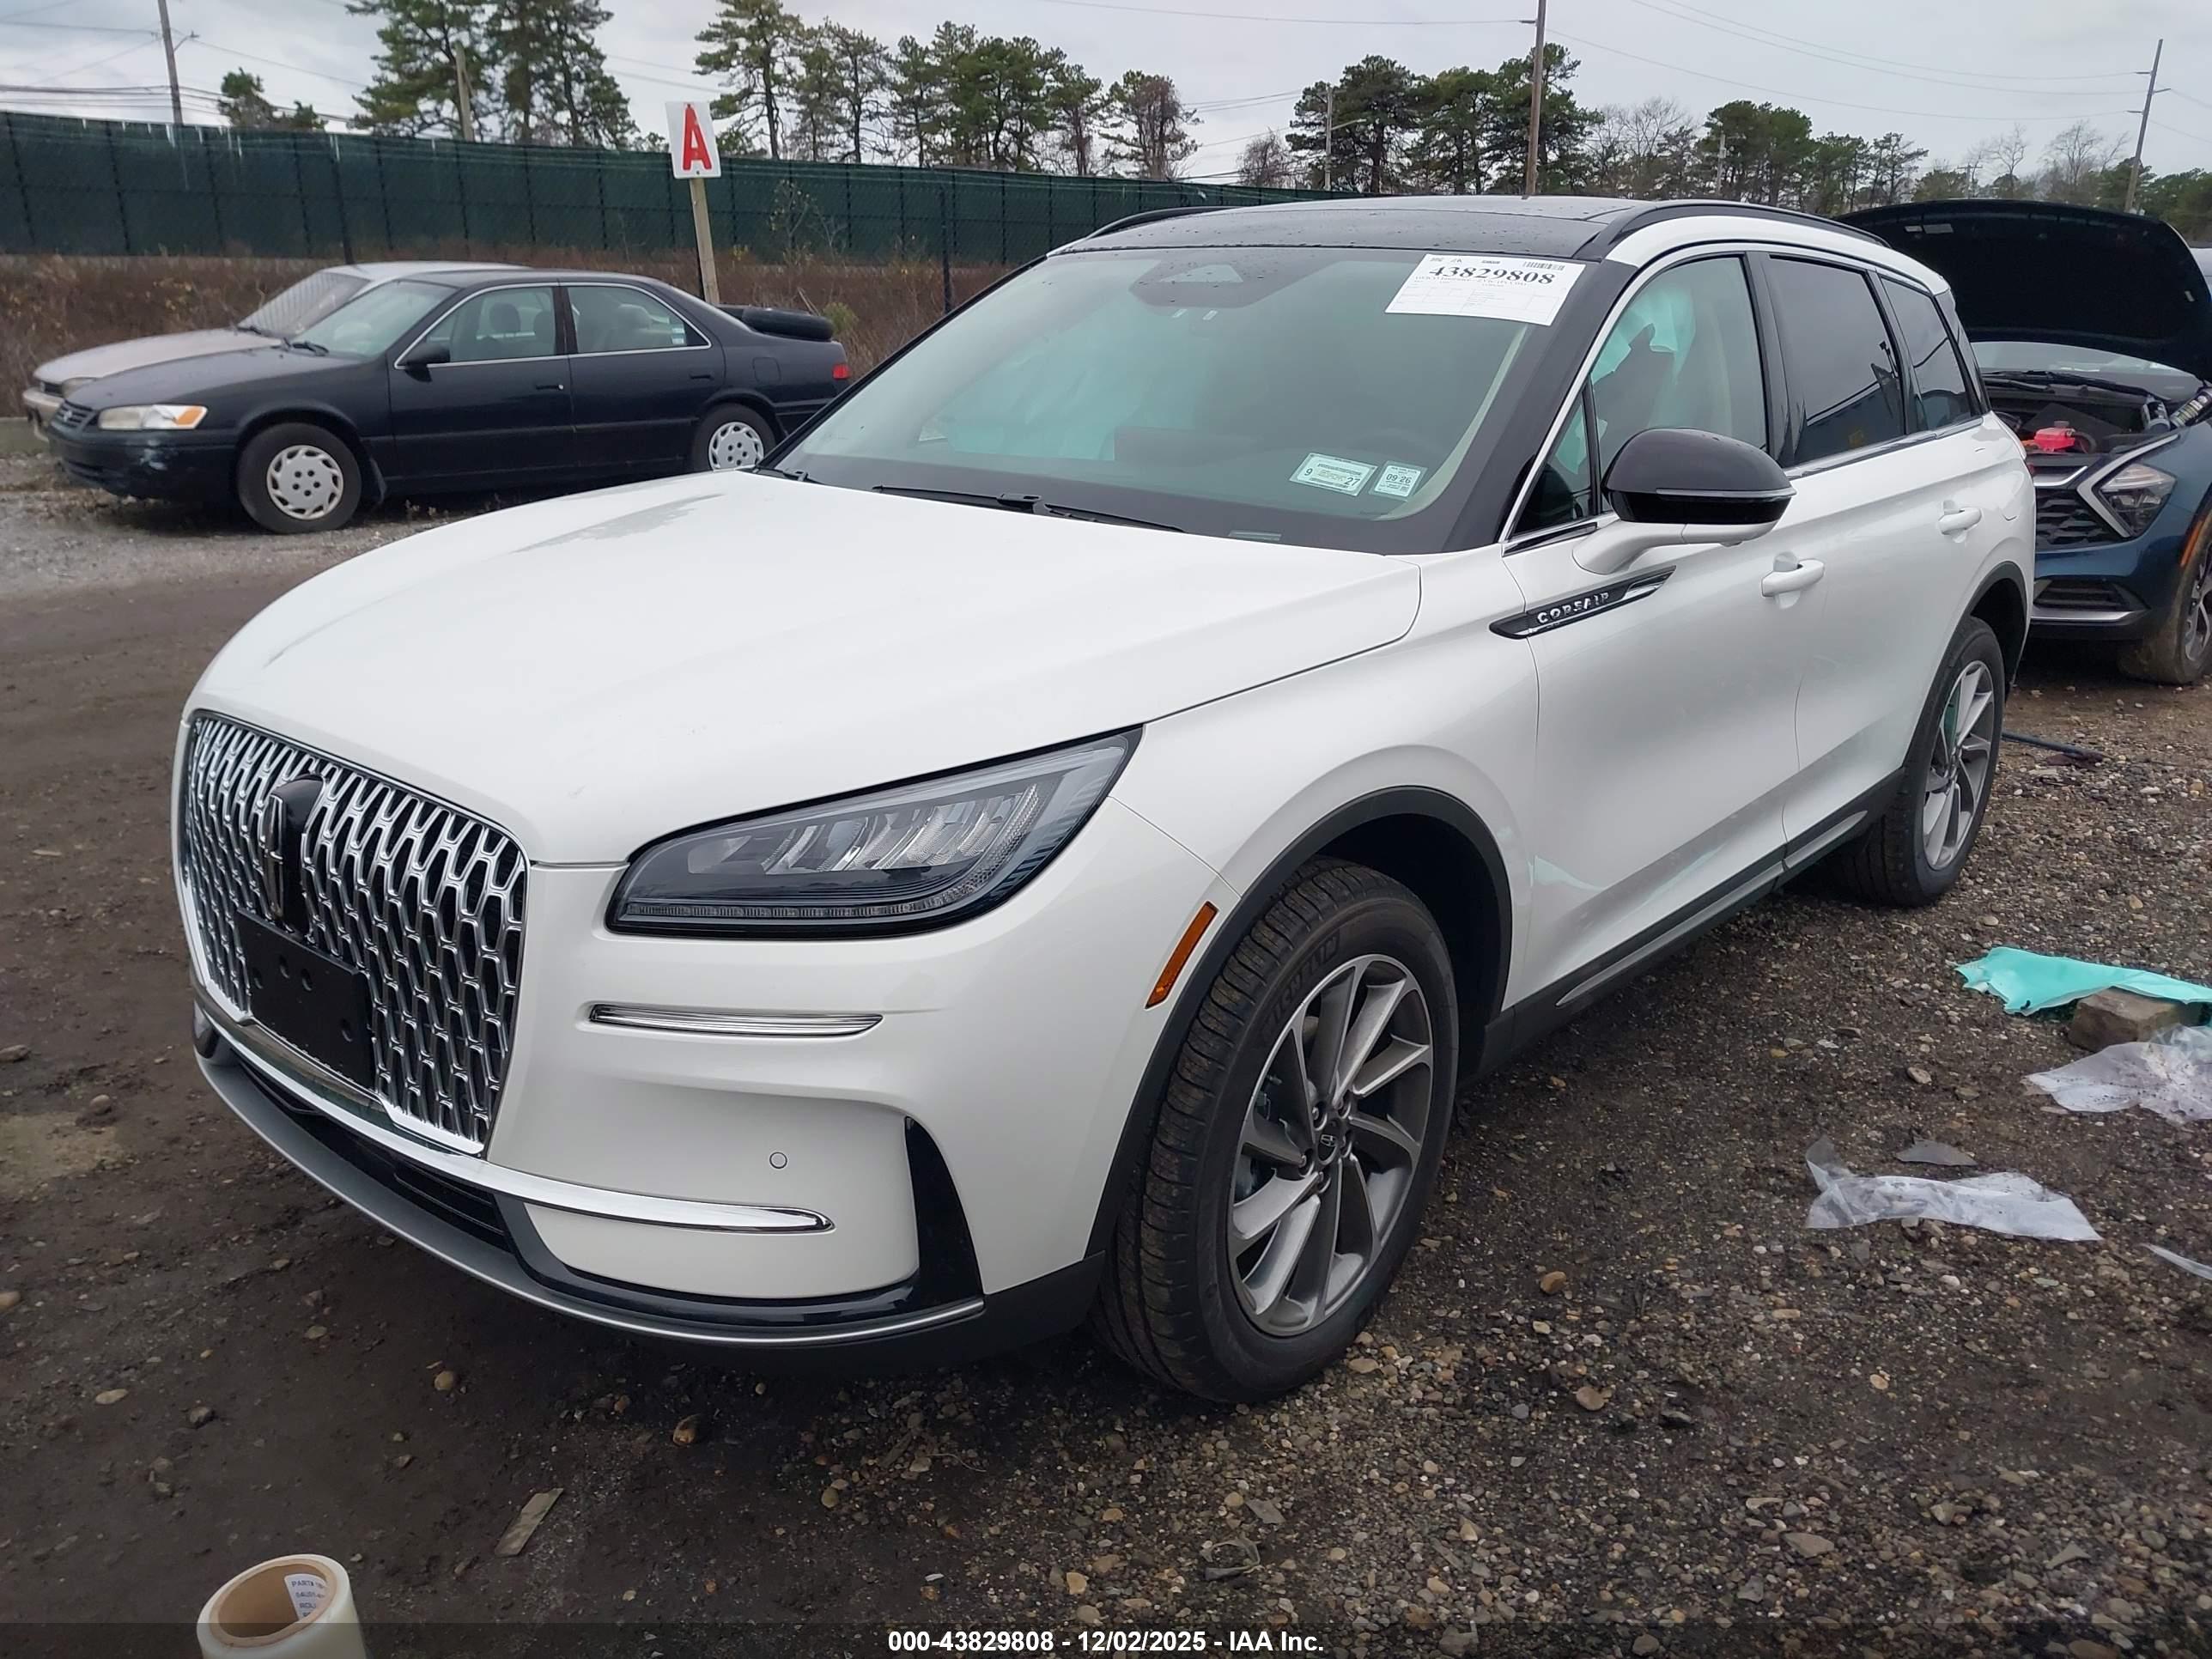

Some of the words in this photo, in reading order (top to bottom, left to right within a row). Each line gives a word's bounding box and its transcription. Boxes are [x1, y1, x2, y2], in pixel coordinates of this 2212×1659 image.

[683, 104, 712, 171] A
[1429, 265, 1556, 285] 43829808
[1304, 468, 1313, 477] 9
[1344, 477, 1360, 487] 27
[1536, 592, 1610, 624] CORSAIR
